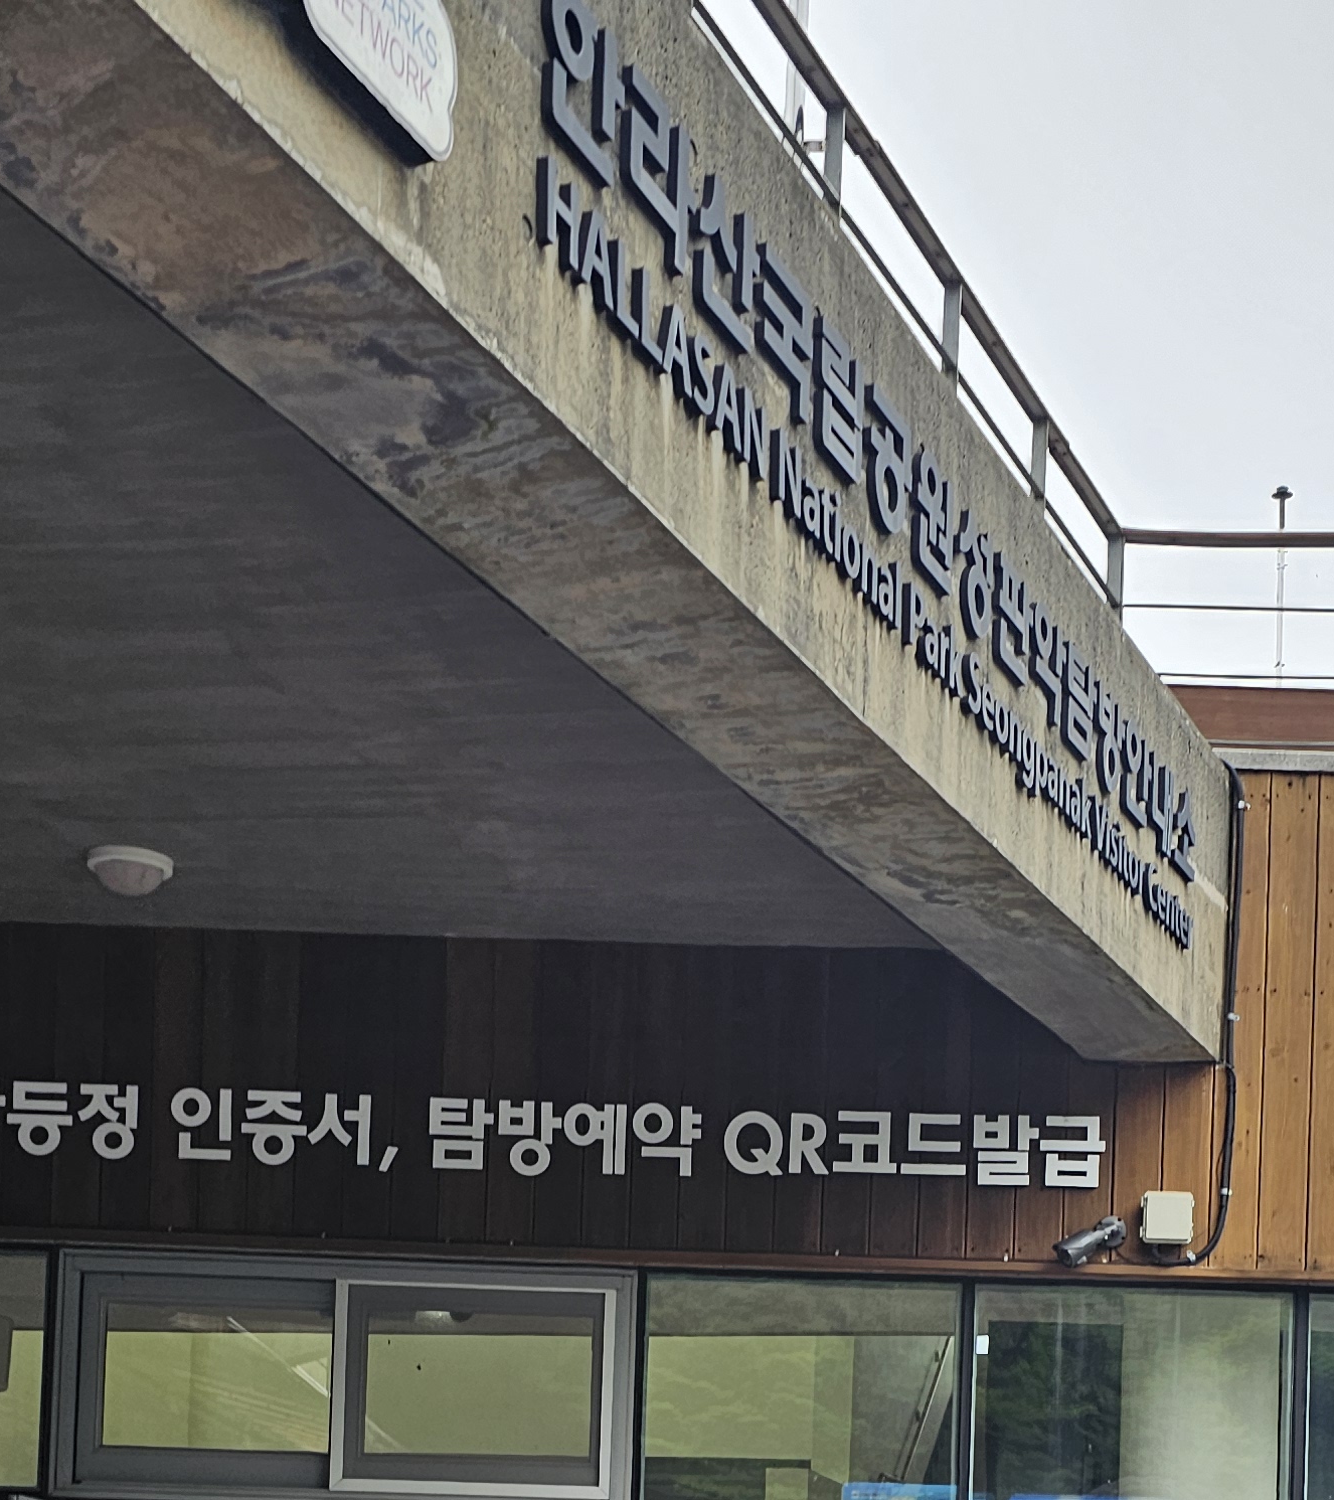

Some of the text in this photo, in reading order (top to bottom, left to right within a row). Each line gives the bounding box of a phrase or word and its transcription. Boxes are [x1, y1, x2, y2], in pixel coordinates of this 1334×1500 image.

[332, 0, 433, 114] ETWORK
[536, 155, 1195, 950] HALLASAN National Park Seongpanak Visitor Center
[170, 1086, 399, 1173] 인증서,
[428, 1096, 703, 1178] 탐방예약
[723, 1110, 1106, 1190] QR코드발급
